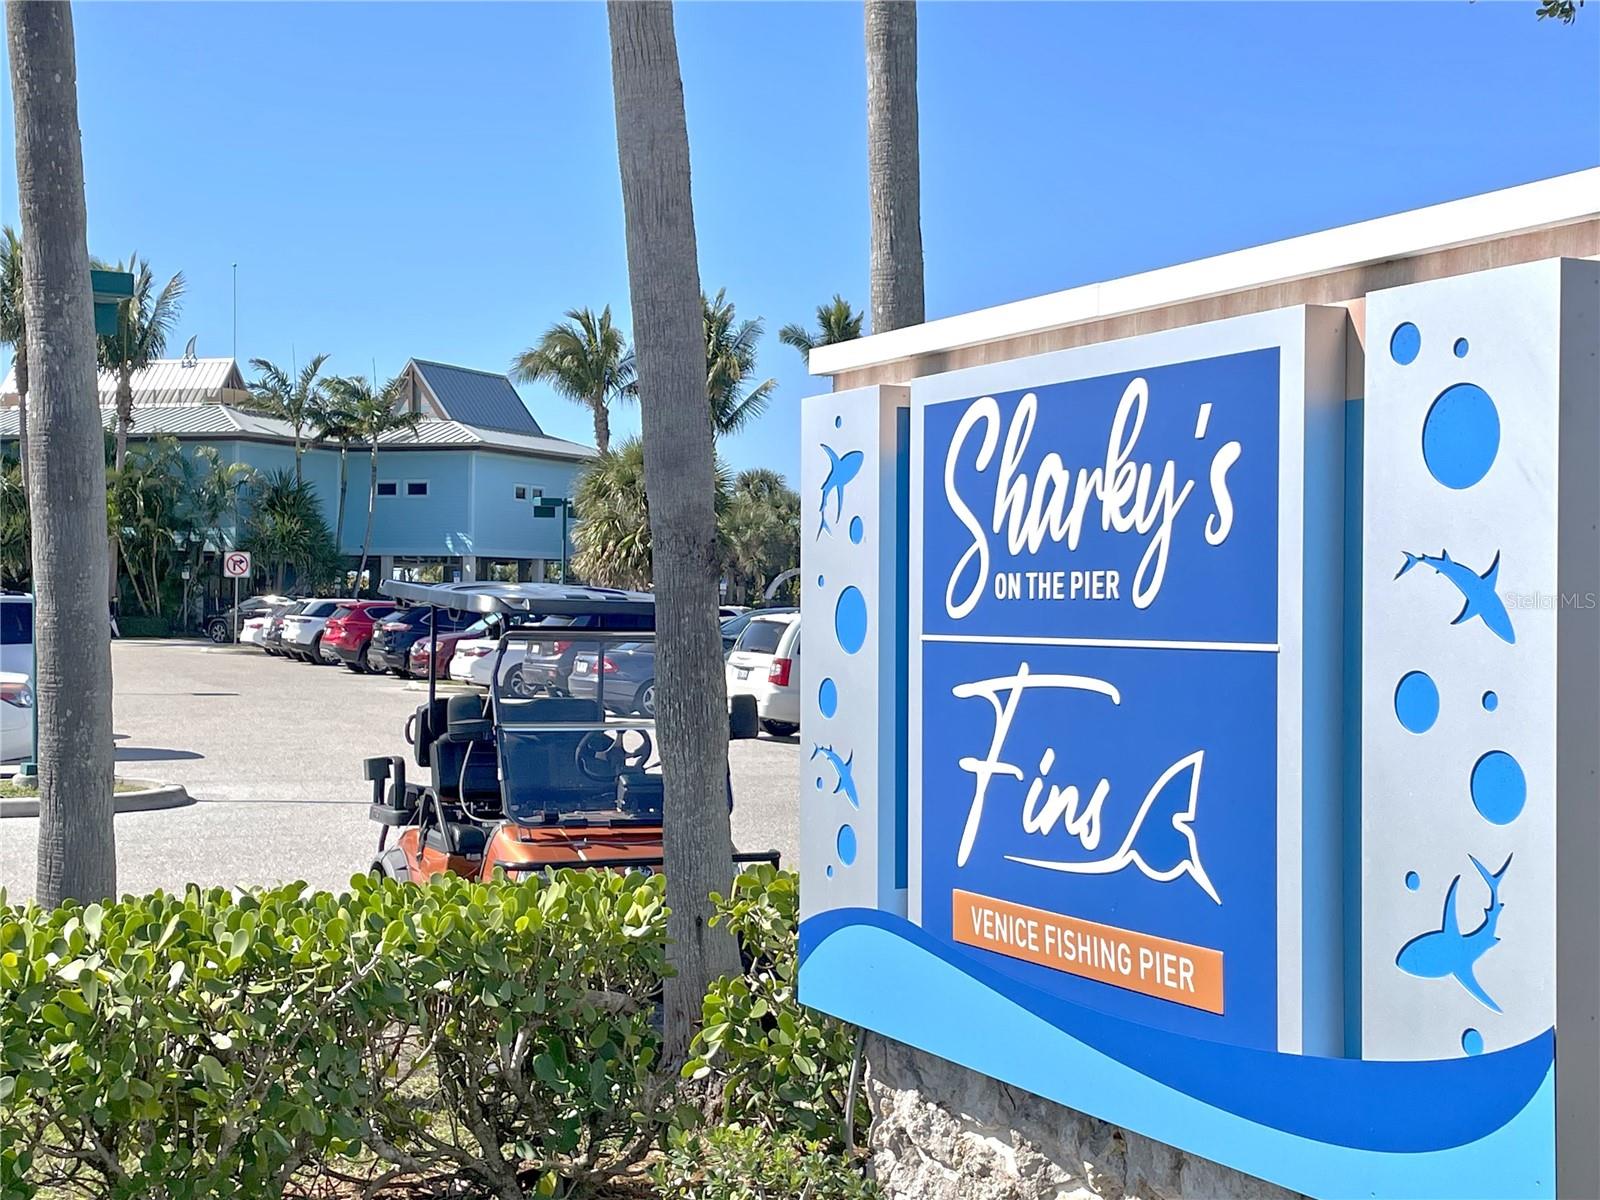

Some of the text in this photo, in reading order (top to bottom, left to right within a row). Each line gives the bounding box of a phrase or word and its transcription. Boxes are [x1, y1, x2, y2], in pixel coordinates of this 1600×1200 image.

[944, 377, 1242, 620] Sharky's
[994, 570, 1120, 600] ON THE PIER
[952, 662, 1121, 868] Fins
[970, 905, 1195, 993] VENICE FISHING PIER
